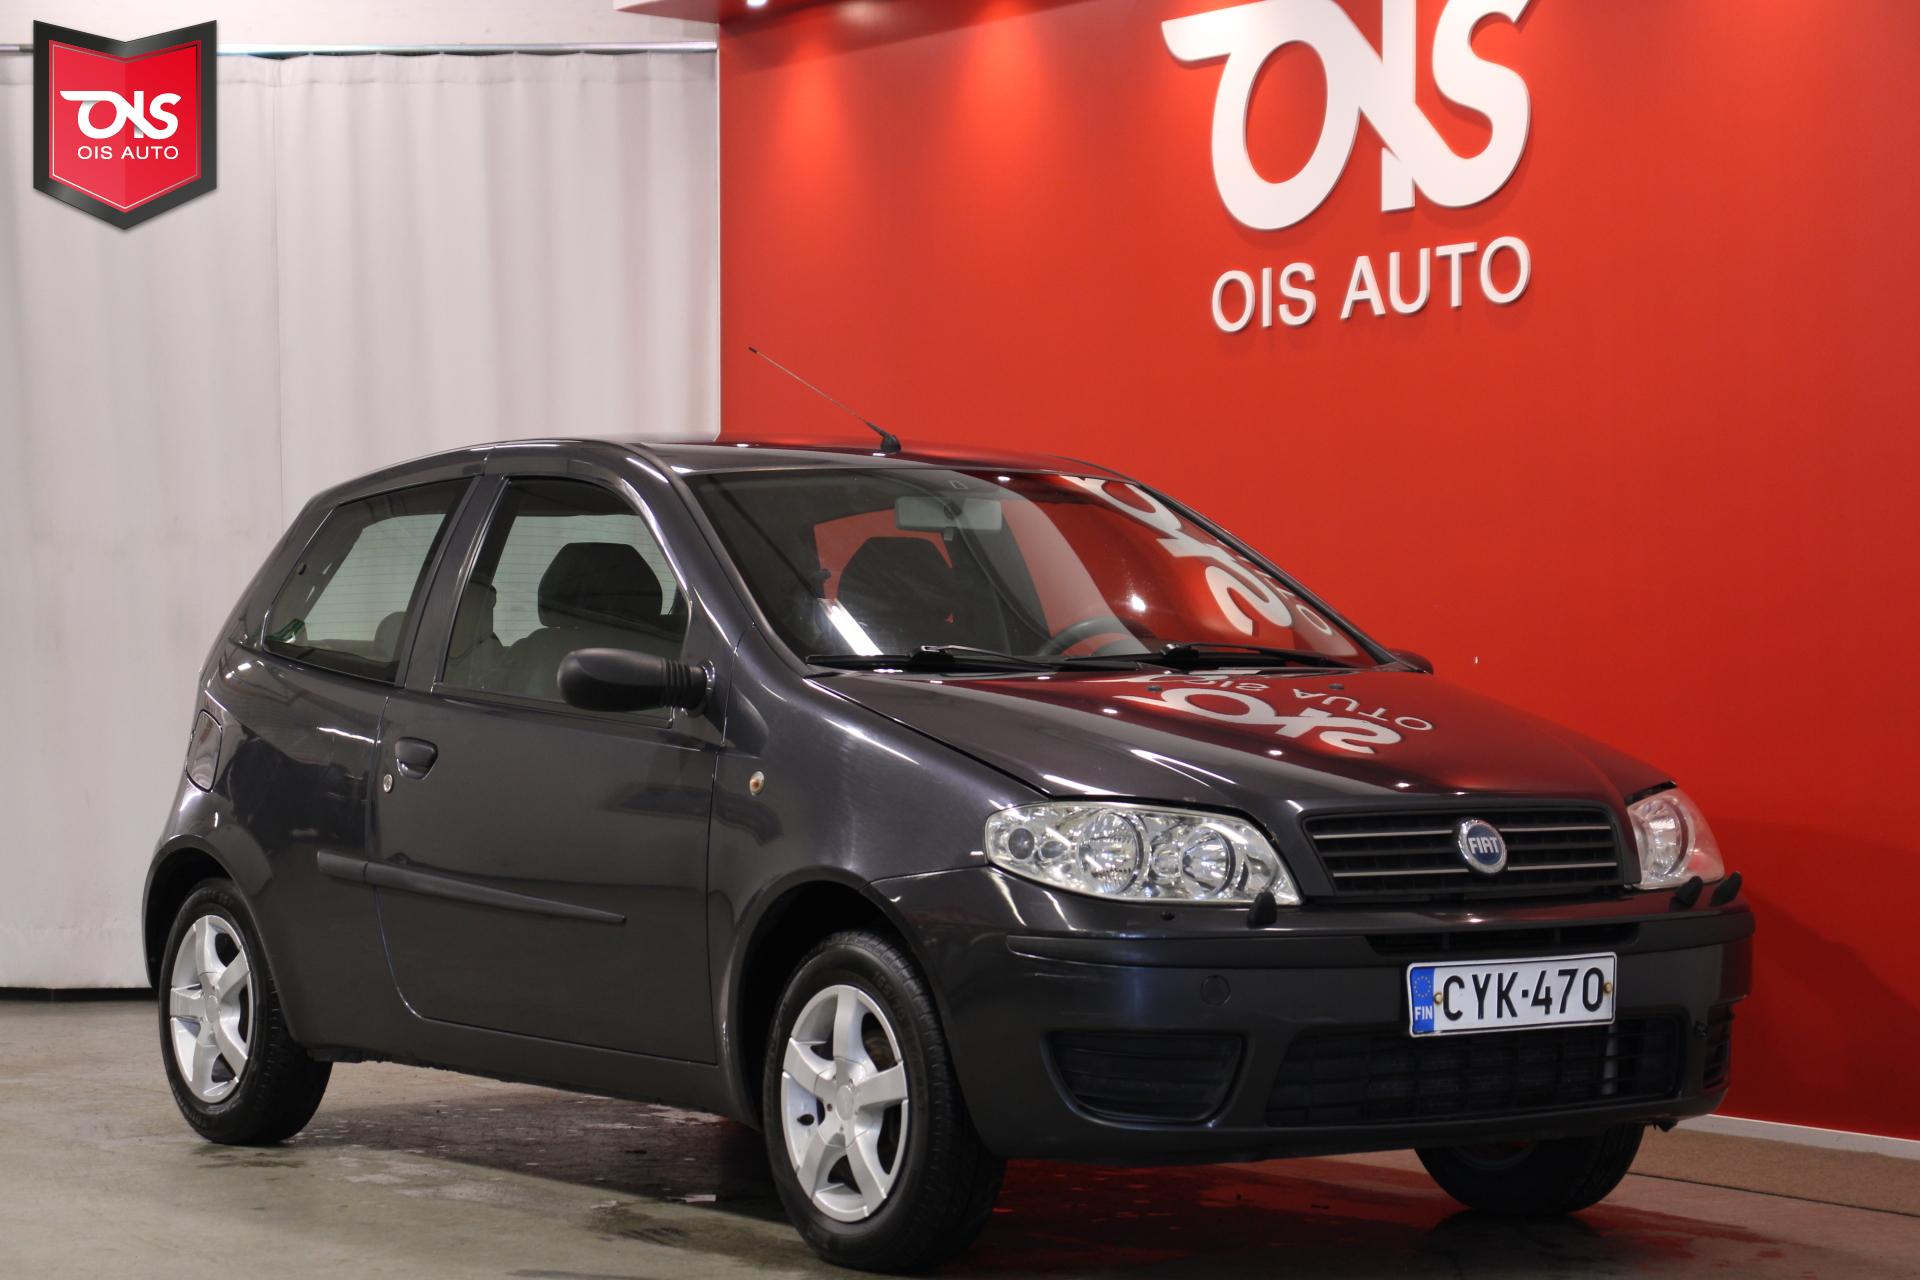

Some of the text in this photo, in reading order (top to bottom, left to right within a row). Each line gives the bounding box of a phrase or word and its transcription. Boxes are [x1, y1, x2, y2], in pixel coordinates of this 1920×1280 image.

[1161, 0, 1532, 231] OIS
[1211, 236, 1531, 333] OIS AUTO
[1468, 837, 1499, 854] FIAT
[1414, 1005, 1433, 1021] FIN
